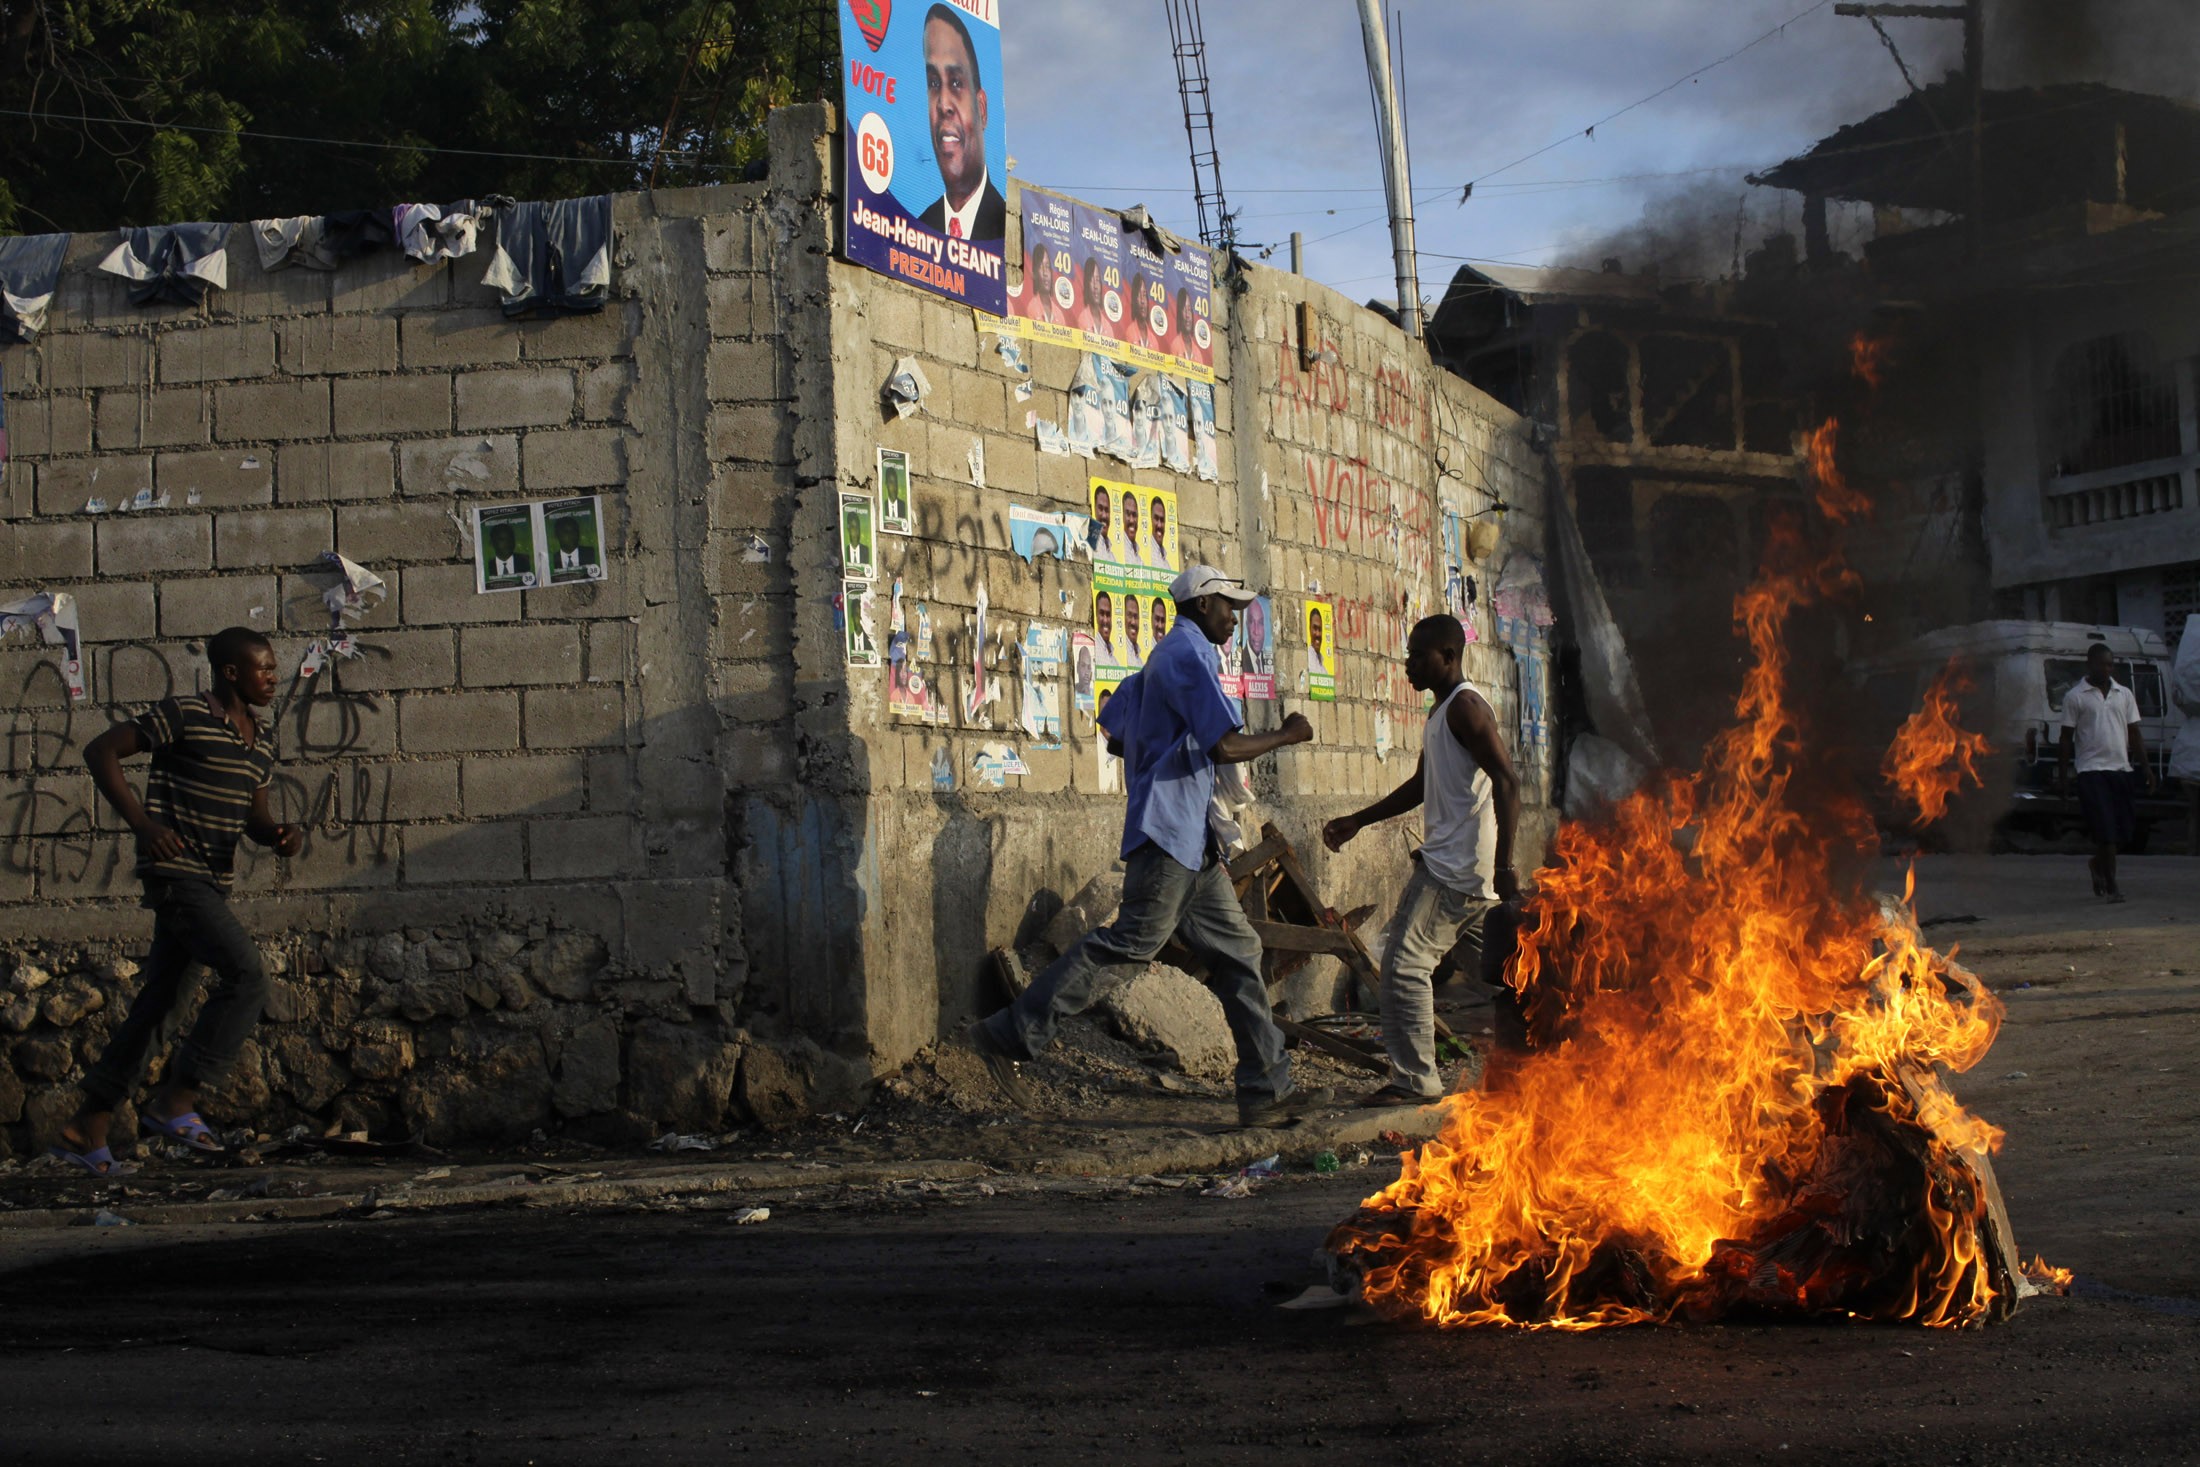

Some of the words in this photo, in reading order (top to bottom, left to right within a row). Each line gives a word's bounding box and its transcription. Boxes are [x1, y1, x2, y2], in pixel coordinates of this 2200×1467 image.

[851, 58, 896, 104] VOTE
[862, 132, 889, 178] 63
[1049, 202, 1069, 218] Régine
[1030, 212, 1070, 233] JEAN-LOUIS
[1098, 219, 1117, 234] Régine
[852, 198, 944, 263] Jean-Henry
[947, 238, 1001, 280] CEANT
[1081, 226, 1118, 249] JEAN-LOUIS
[1053, 250, 1071, 274] 40
[1189, 252, 1207, 267] Régine
[889, 247, 965, 296] PREZIDAN
[1103, 265, 1119, 288] 40
[1174, 260, 1208, 280] JEAN-LOUIS
[1150, 281, 1165, 303] 40
[1194, 295, 1208, 318] 40
[1000, 316, 1021, 327] bouke!
[1052, 325, 1072, 337] bouke!
[1101, 337, 1120, 350] bouke!
[1147, 351, 1165, 363] bouke!
[1191, 362, 1208, 375] bouke!
[1085, 390, 1098, 405] 40
[1191, 386, 1211, 400] BAKER
[1116, 400, 1128, 415] 40
[1176, 415, 1186, 428] 40
[1204, 421, 1214, 435] 40
[1307, 457, 1391, 547] VOTEZ
[1221, 682, 1237, 693] LEXIS
[1248, 681, 1268, 692] ALEXIS
